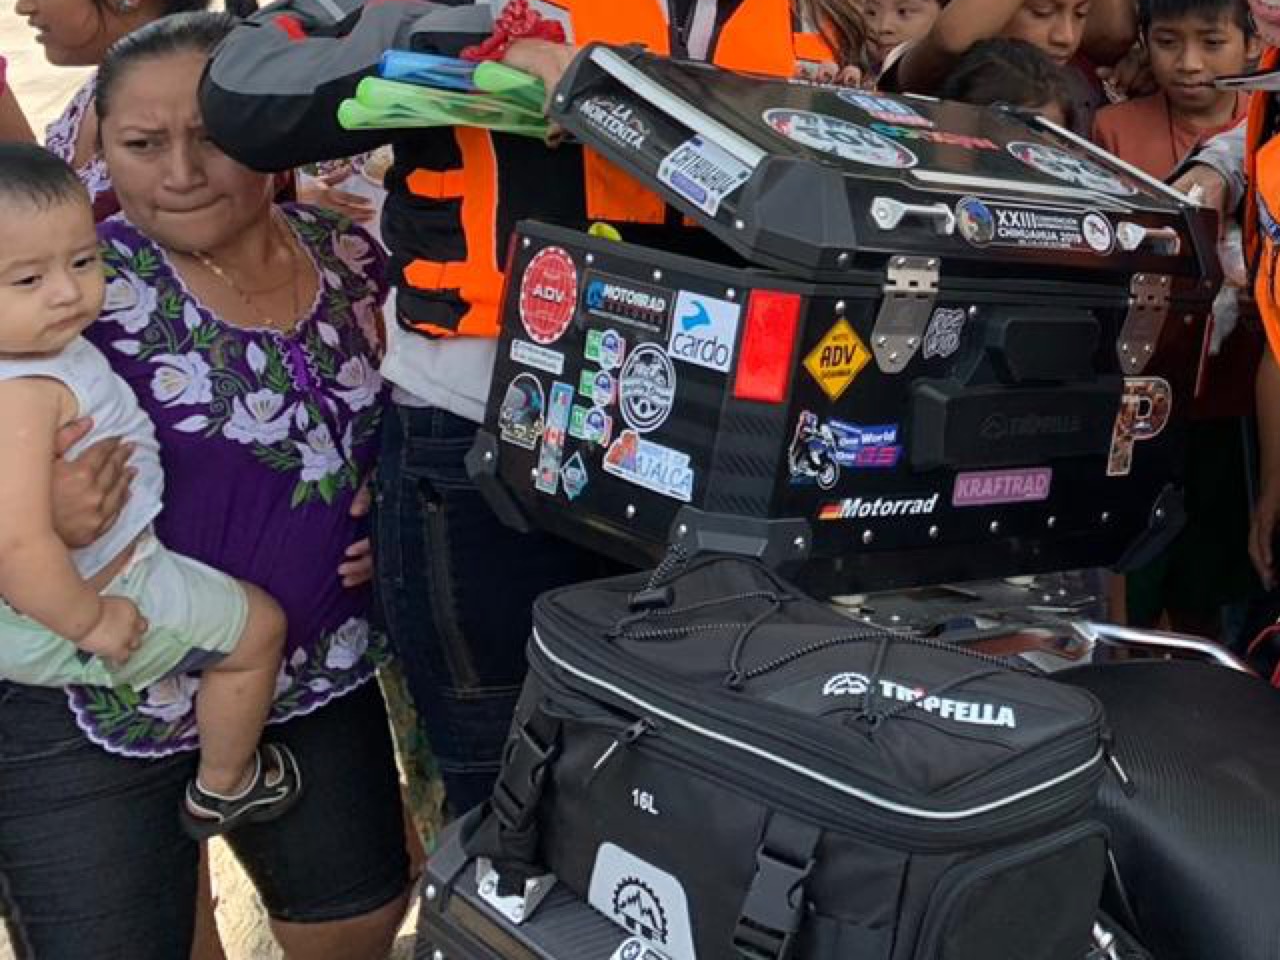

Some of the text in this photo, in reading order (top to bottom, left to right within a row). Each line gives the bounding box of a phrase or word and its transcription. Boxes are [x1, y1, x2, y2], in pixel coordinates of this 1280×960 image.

[612, 103, 633, 121] LA
[995, 210, 1037, 229] XXIII
[531, 283, 566, 304] ADV
[602, 283, 667, 312] MOTORRAD
[671, 332, 730, 367] cardo
[819, 343, 857, 370] ADV
[860, 428, 897, 444] World
[956, 470, 1050, 501] KRAFTRAD
[838, 493, 941, 519] Motorrad
[630, 786, 661, 816] 16L
